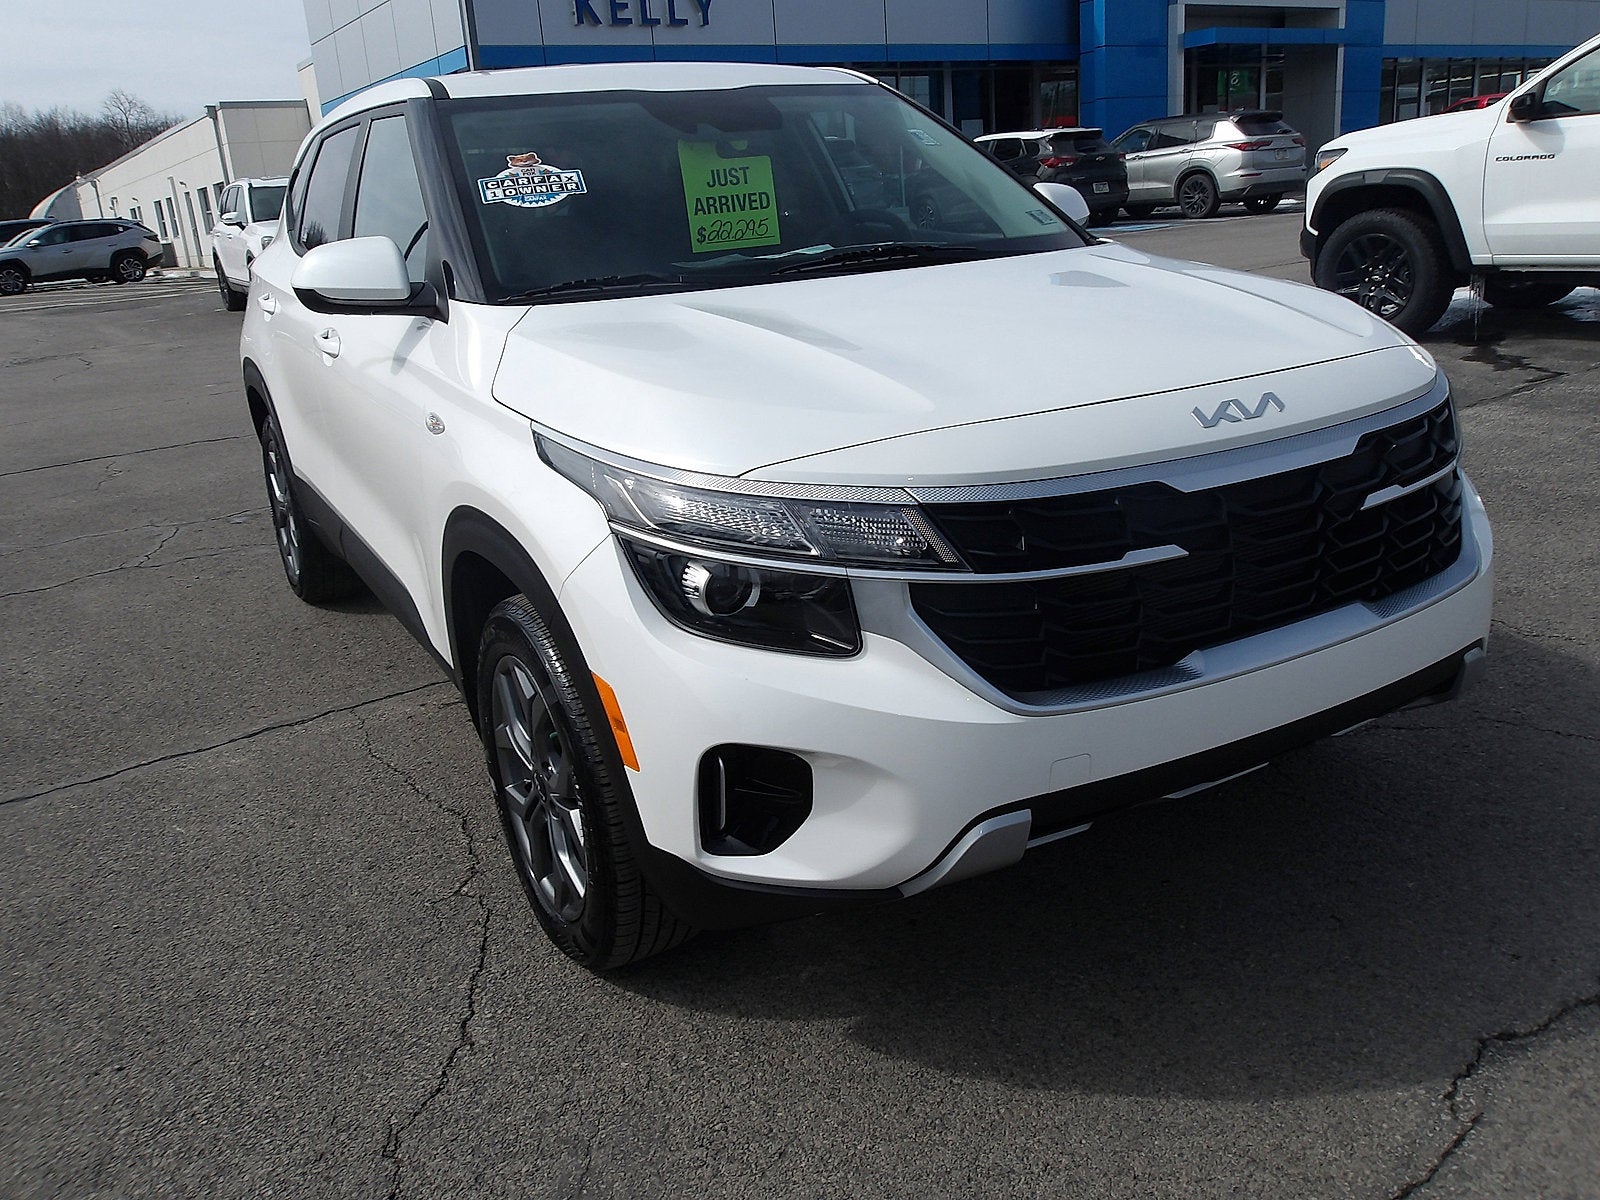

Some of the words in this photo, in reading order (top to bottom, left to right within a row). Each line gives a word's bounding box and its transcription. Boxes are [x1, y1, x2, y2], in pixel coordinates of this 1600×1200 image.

[574, 0, 711, 25] KELLY
[487, 175, 575, 190] CARFAX
[707, 166, 750, 188] JUST
[491, 190, 500, 198] 1
[505, 182, 577, 196] OWNER
[694, 191, 771, 216] ARRIVED
